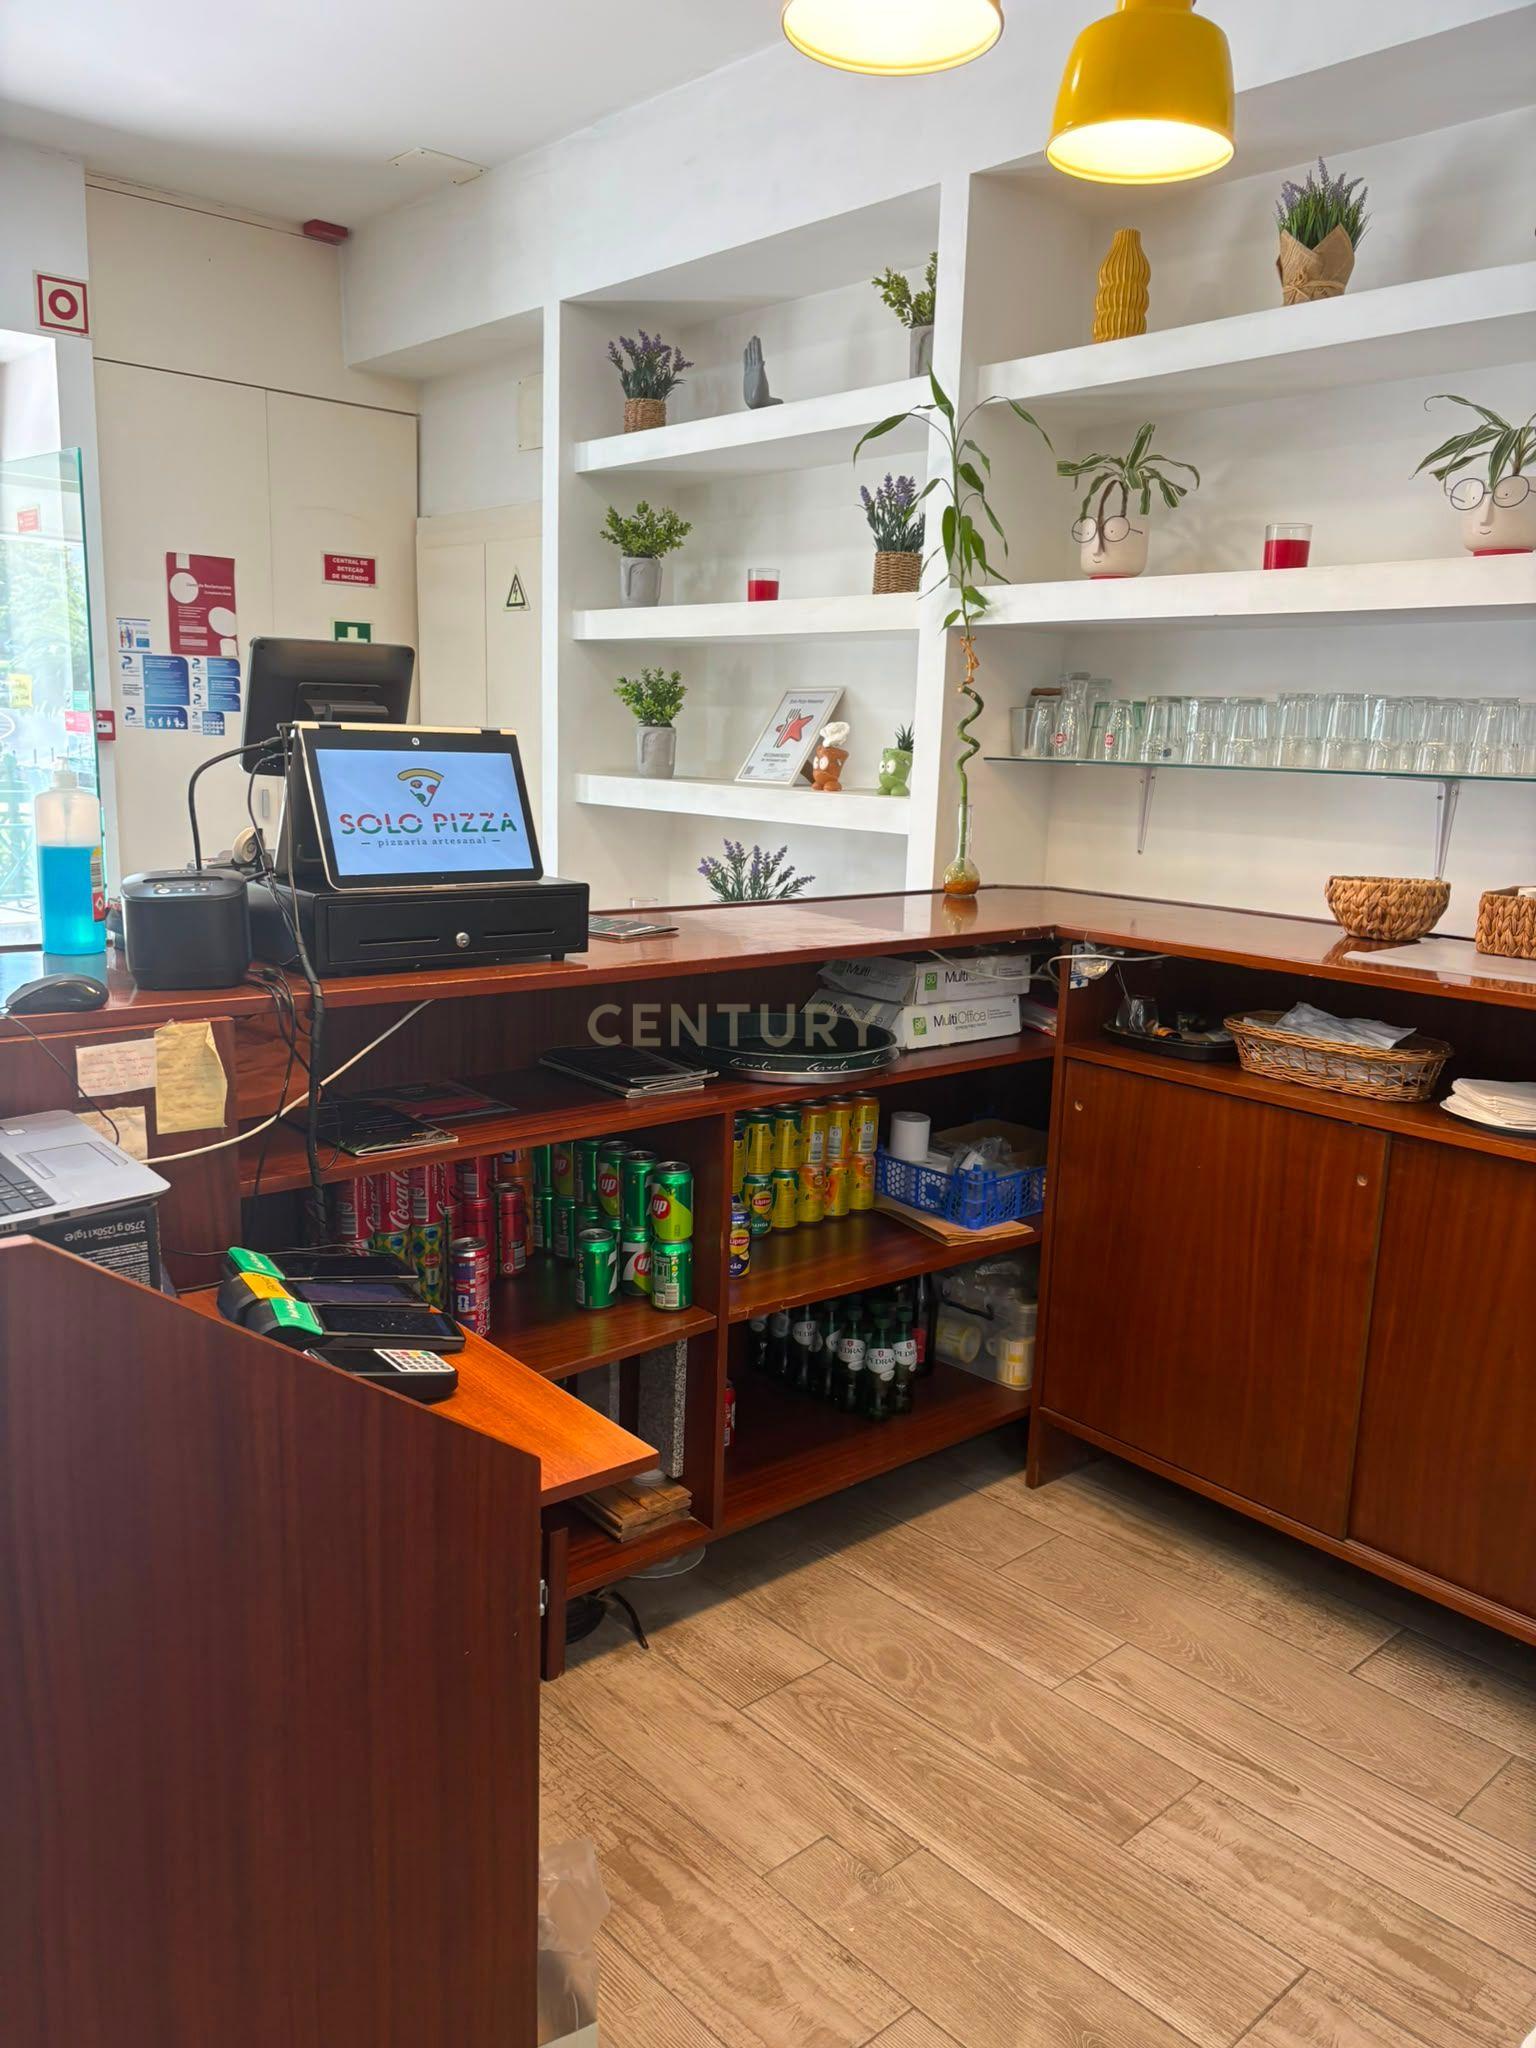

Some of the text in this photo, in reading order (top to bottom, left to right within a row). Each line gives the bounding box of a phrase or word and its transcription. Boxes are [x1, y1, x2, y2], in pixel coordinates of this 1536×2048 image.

[332, 557, 359, 565] CENTRAL
[341, 573, 369, 582] INCÊNDIO
[339, 812, 518, 835] SOLO PIZZA
[378, 836, 487, 848] pizzaria artesanal
[124, 1220, 145, 1234] 2750
